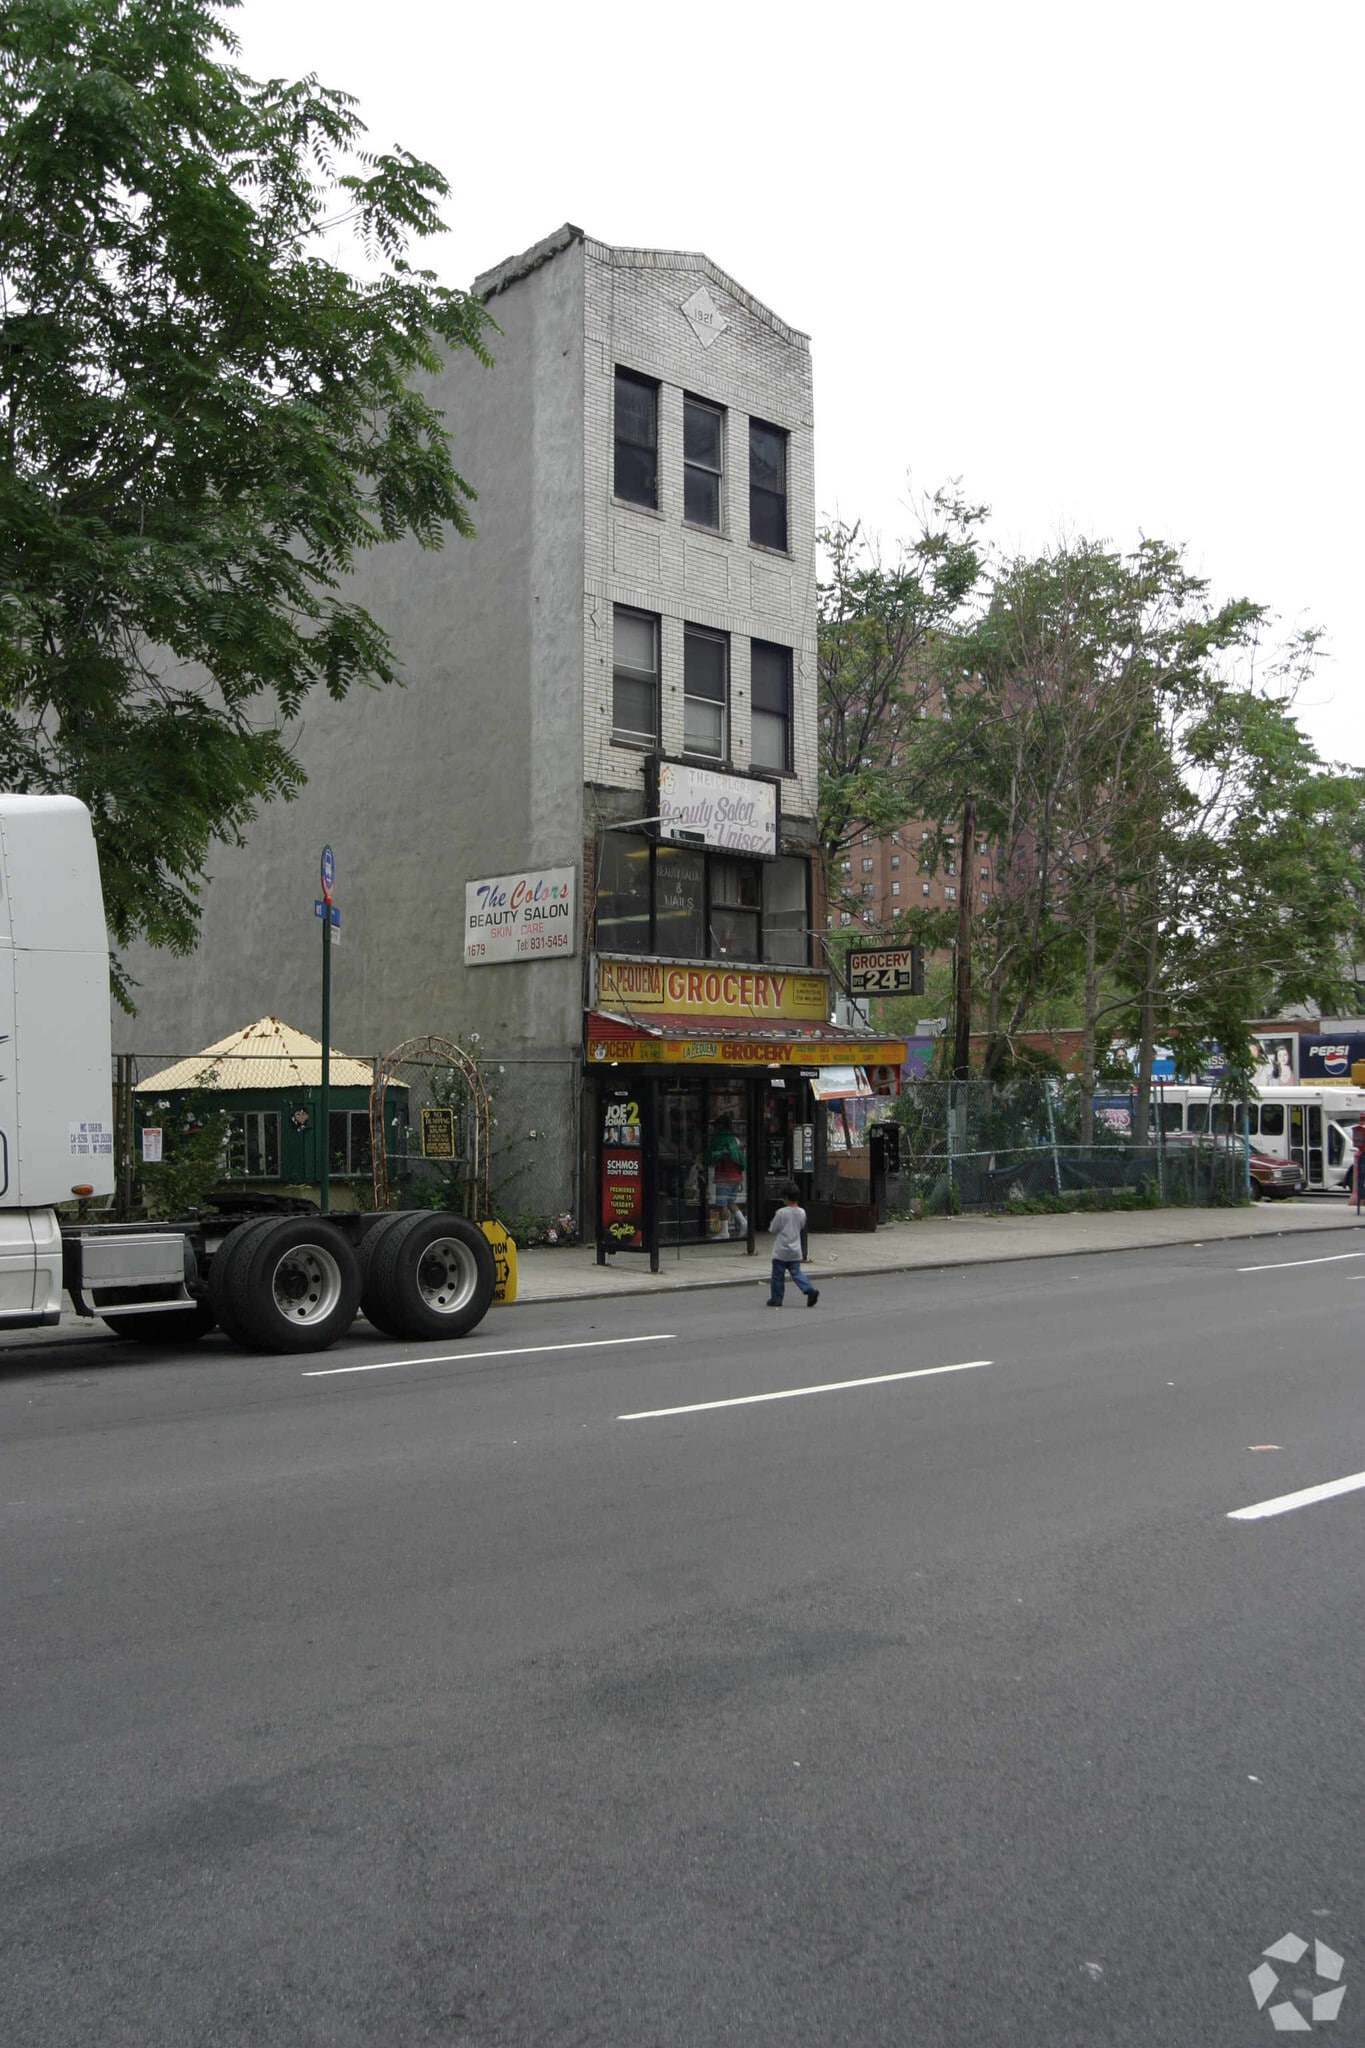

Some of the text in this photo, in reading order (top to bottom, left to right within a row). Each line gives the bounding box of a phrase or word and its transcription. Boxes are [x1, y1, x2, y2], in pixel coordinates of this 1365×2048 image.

[714, 823, 772, 853] Unisex
[477, 880, 569, 910] The Colors
[470, 903, 569, 928] BEAUTY SALON
[491, 922, 544, 939] SKIN CARE
[467, 944, 486, 956] 1679
[531, 935, 568, 950] 831-5454
[853, 953, 909, 969] GROCERY
[602, 965, 613, 991] LA
[667, 970, 786, 1009] GROCERY
[865, 969, 898, 990] 24
[590, 1041, 635, 1058] GOCERY
[722, 1044, 792, 1060] GROCERY
[1309, 1045, 1349, 1056] PEPSI
[607, 1102, 640, 1125] JOE 2
[607, 1160, 639, 1169] SCHMOS
[609, 1222, 635, 1240] Spike
